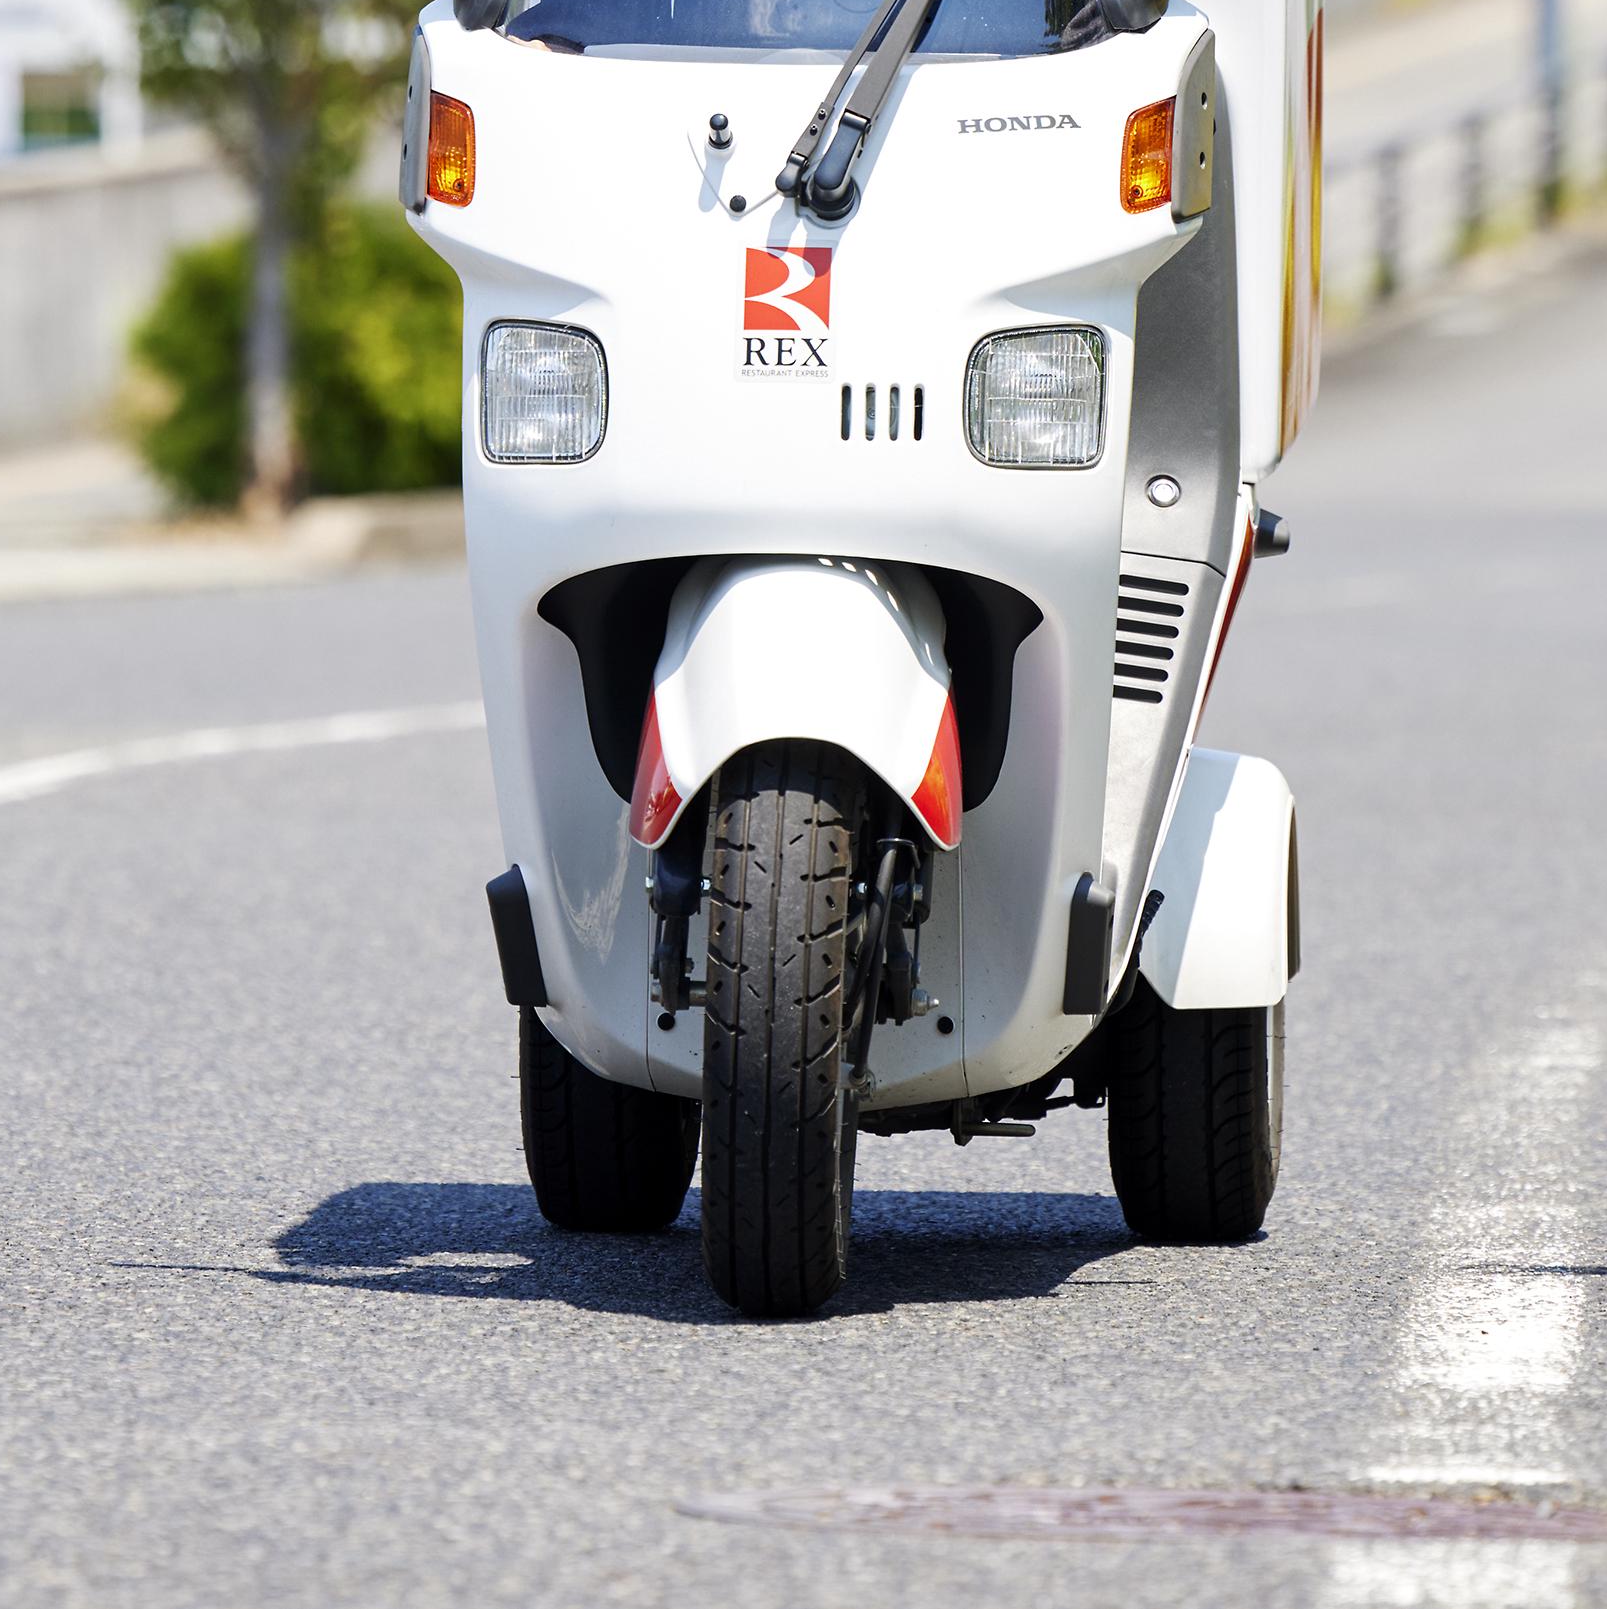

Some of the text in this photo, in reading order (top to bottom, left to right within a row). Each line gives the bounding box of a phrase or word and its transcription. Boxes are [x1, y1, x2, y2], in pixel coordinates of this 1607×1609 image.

[957, 114, 1082, 134] HONDA
[742, 337, 829, 367] REX
[741, 369, 829, 378] RESTAURANT EXPRESS
